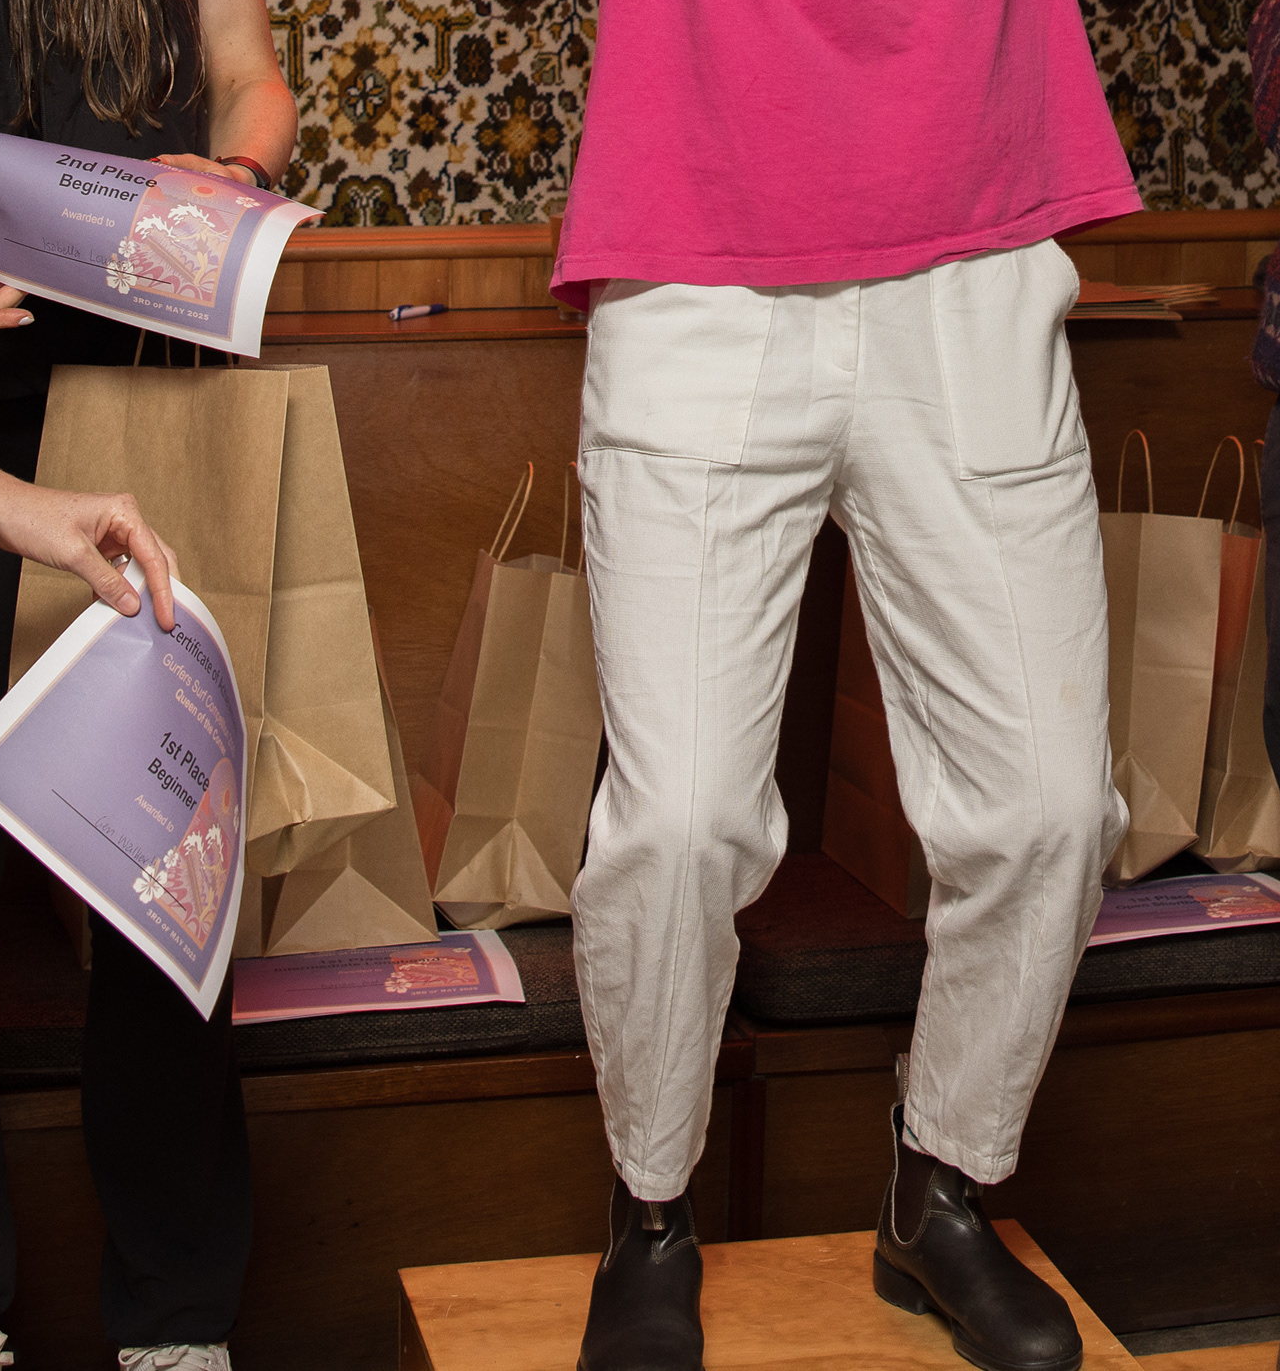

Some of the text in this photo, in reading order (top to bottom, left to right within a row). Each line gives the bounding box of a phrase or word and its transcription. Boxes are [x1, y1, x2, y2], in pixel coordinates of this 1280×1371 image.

[55, 154, 158, 188] 2nd Place
[58, 173, 139, 202] Beginner
[61, 208, 115, 228] Awarded to
[132, 296, 151, 306] 3RD
[165, 304, 185, 315] MAY
[187, 309, 210, 321] 2025
[169, 623, 220, 685] Certificate of
[162, 652, 193, 687] Gurfers
[191, 679, 208, 702] Surf
[175, 688, 198, 717] Queen
[197, 710, 206, 724] of
[160, 731, 210, 792] 1st Place
[147, 757, 197, 810] Beginner
[134, 794, 175, 832] Awarded to
[146, 909, 162, 925] 3RD
[170, 930, 184, 947] MAY
[183, 944, 197, 962] 2025
